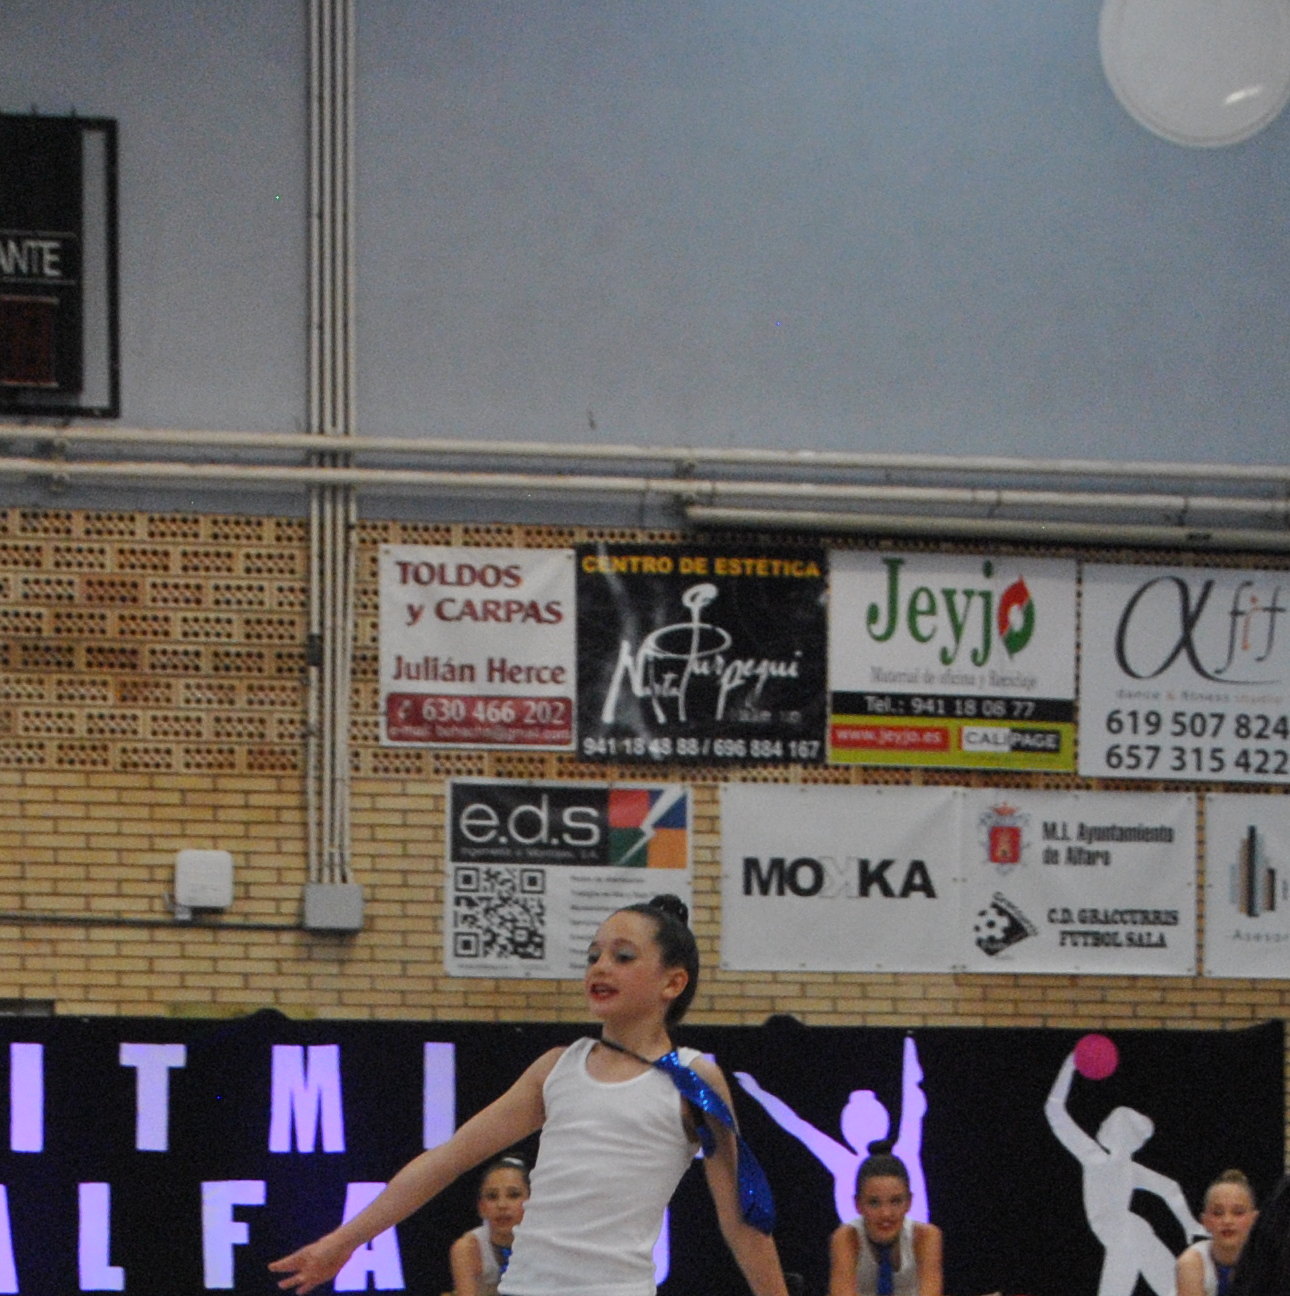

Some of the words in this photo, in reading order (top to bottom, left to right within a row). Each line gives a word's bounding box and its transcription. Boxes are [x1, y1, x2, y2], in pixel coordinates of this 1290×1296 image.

[395, 561, 524, 588] TOLDOS
[582, 555, 674, 575] CENTRO
[678, 557, 709, 575] DE
[406, 603, 426, 627] y
[434, 598, 564, 625] CARPAS
[866, 556, 1035, 668] Jeyjo
[393, 655, 476, 683] Julián
[486, 657, 566, 685] Herce
[422, 698, 466, 721] 630
[472, 700, 516, 724] 466
[523, 701, 566, 726] 202
[911, 697, 946, 716] 941
[955, 698, 978, 717] 18
[1011, 701, 1036, 719] 77
[1106, 710, 1162, 736] 619
[1170, 712, 1226, 738] 507
[1233, 713, 1290, 740] 824
[582, 737, 616, 756] 941
[713, 738, 747, 758] 696
[750, 739, 784, 758] 884
[1106, 744, 1162, 770] 657
[1170, 746, 1226, 773] 315
[1233, 749, 1289, 775] 422
[1076, 822, 1176, 845] Ayuntamiento
[1042, 846, 1060, 865] de
[1065, 846, 1112, 867] Alfaro
[1077, 908, 1180, 927] GRACCURRIS
[1059, 930, 1123, 948] FUTBOL
[1125, 931, 1168, 949] SALA
